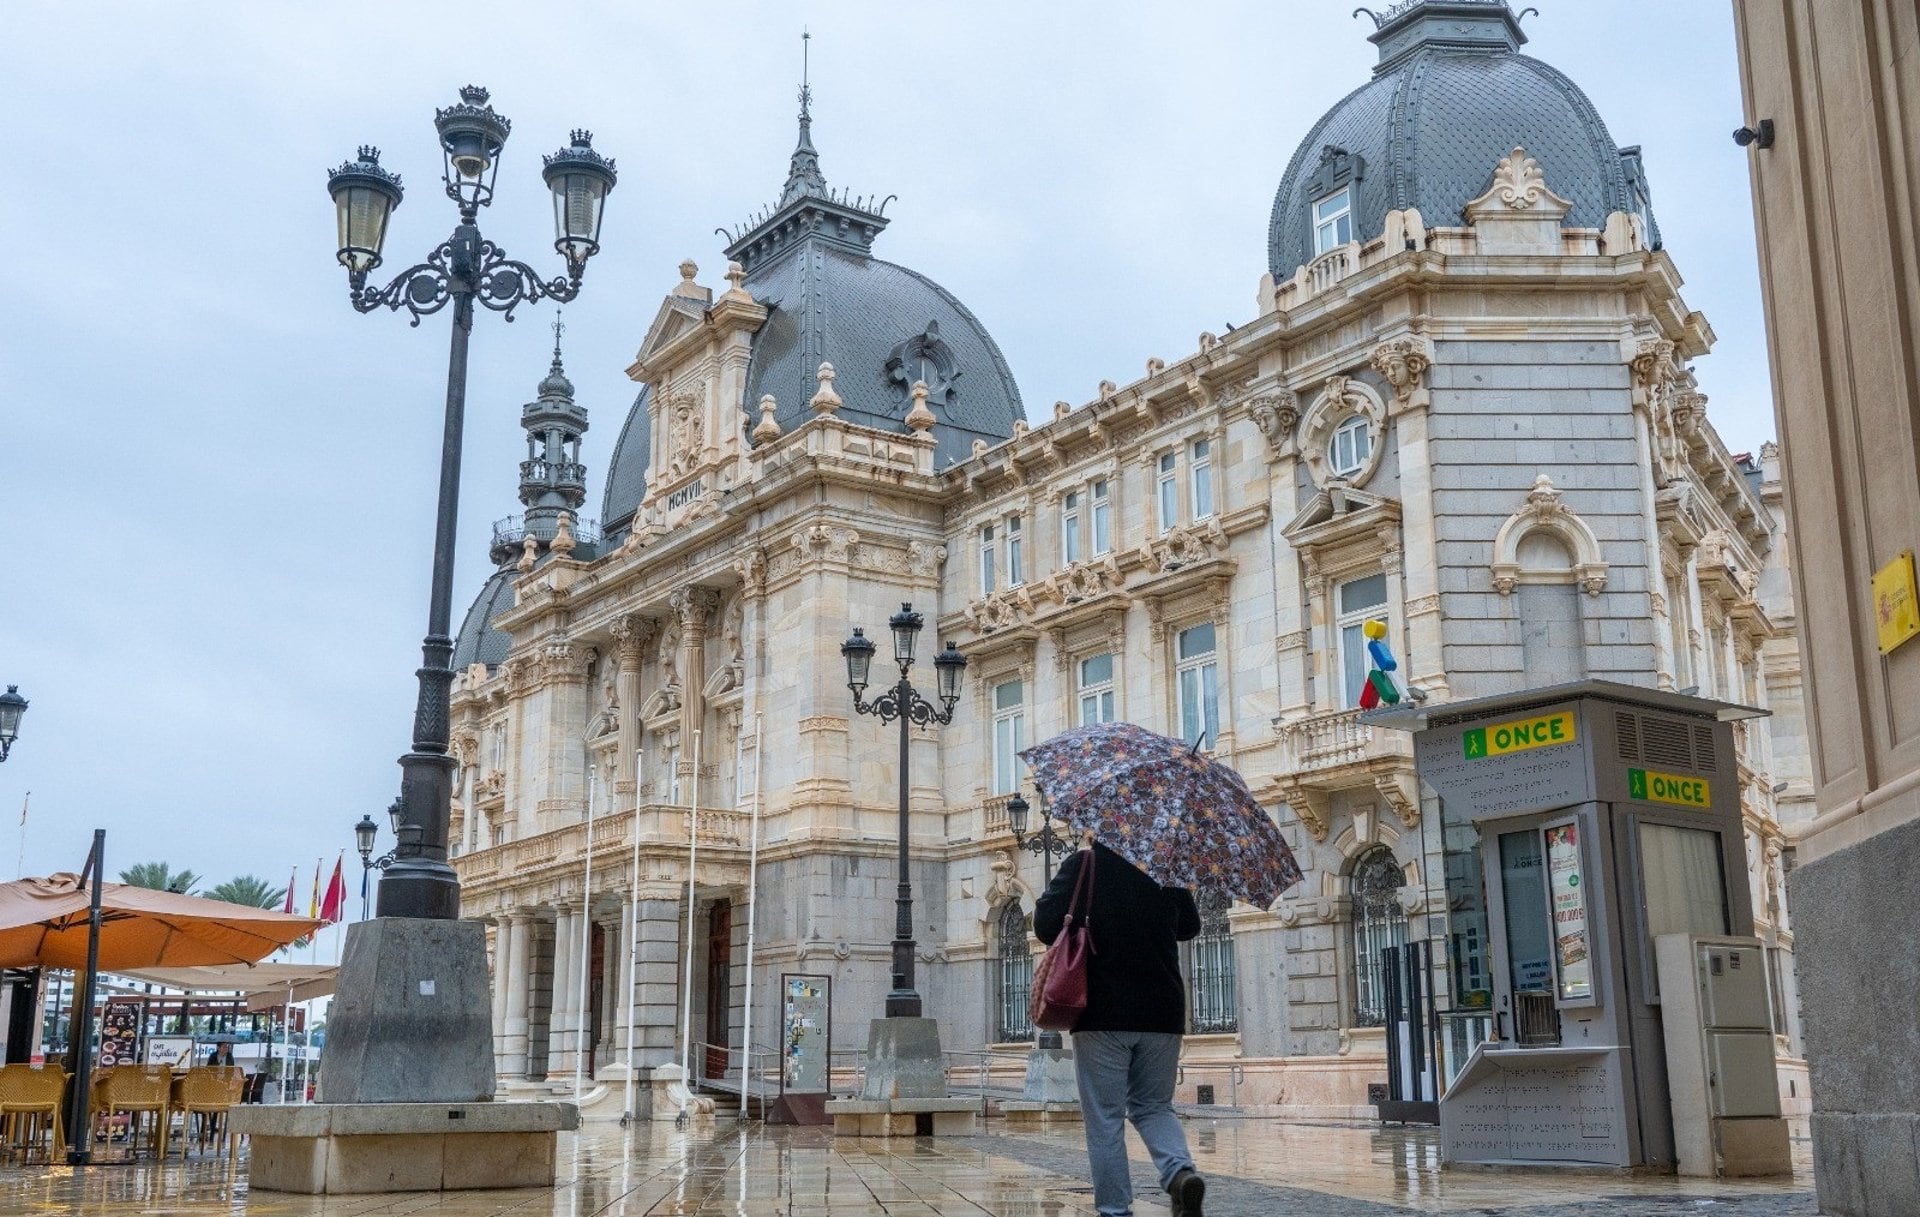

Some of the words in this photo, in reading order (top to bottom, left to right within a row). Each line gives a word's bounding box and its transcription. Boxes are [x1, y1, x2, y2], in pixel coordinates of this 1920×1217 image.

[668, 480, 701, 511] MCMVII
[1494, 718, 1565, 749] ONCE
[1653, 776, 1705, 803] ONCE
